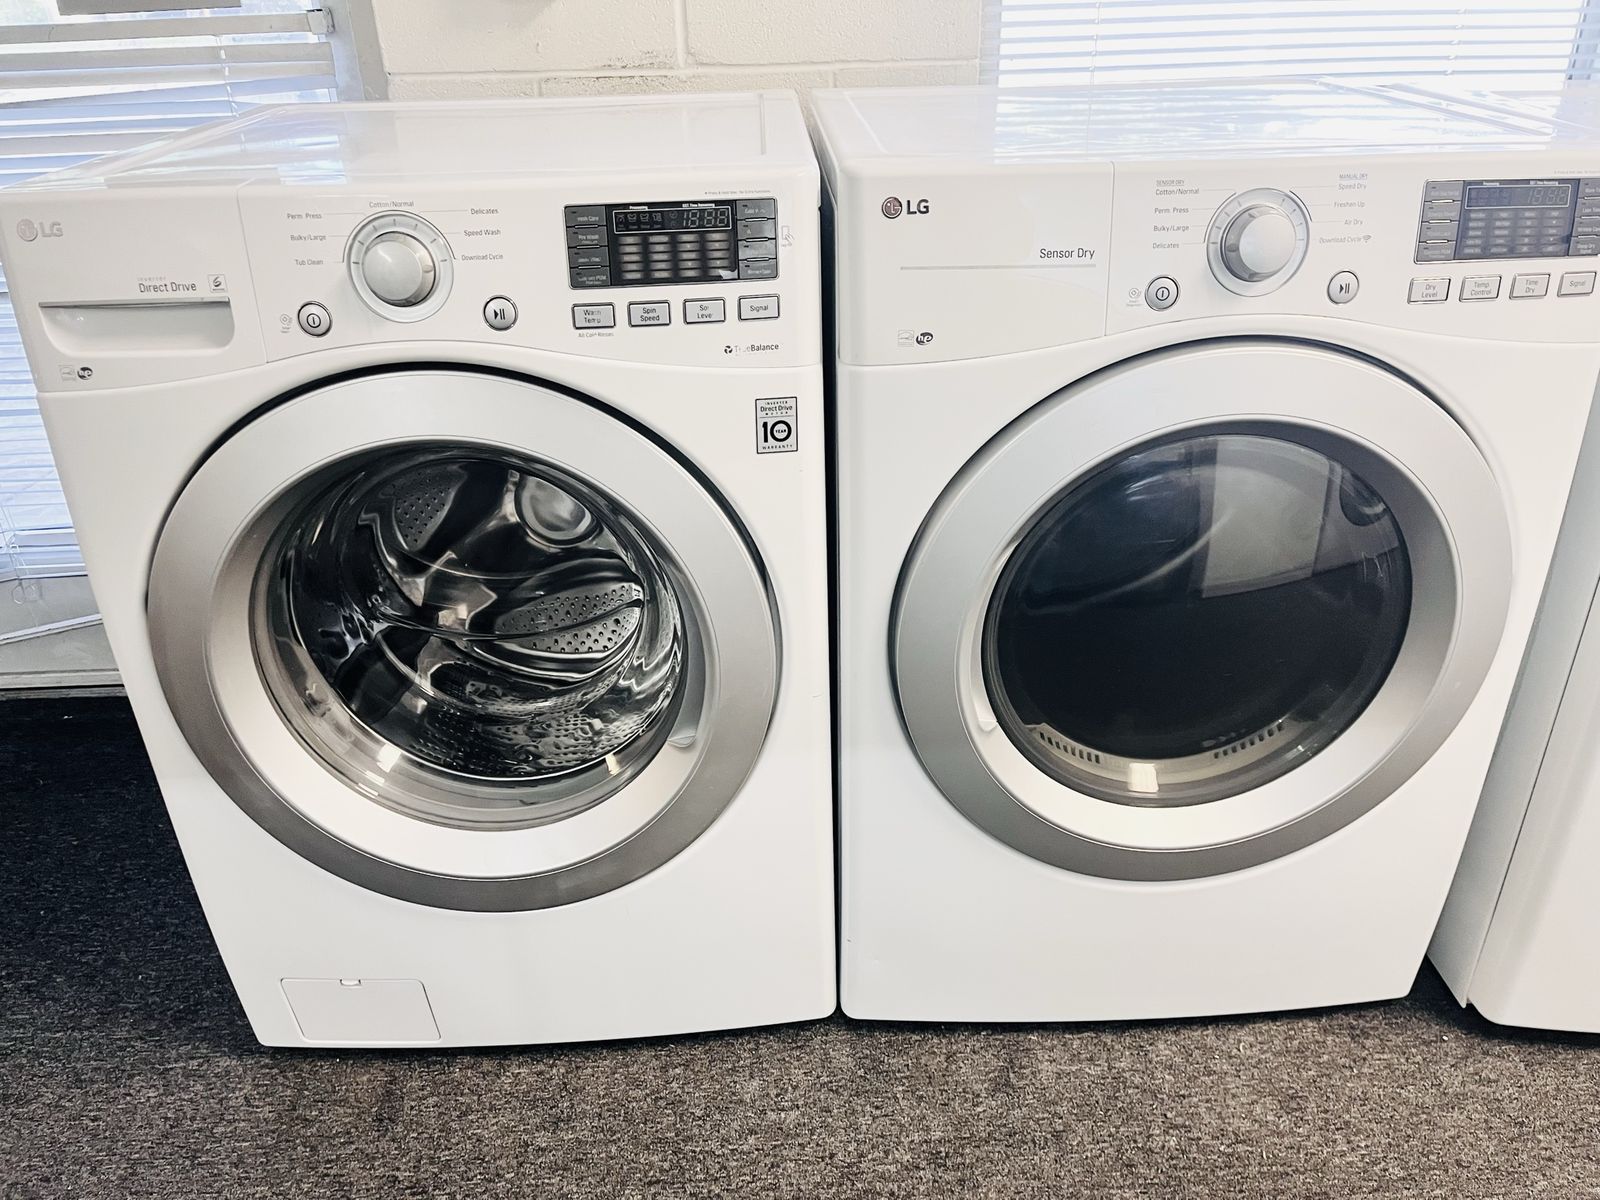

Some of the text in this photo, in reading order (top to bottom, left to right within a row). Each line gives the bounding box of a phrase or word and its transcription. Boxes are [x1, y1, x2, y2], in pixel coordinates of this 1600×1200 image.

[1156, 188, 1200, 196] Cotton/Normal
[369, 200, 414, 208] Cotton/Normal
[906, 199, 930, 215] LG
[1354, 218, 1363, 226] Dry
[38, 221, 64, 238] LG
[1154, 224, 1190, 232] Bulky/Large
[463, 229, 482, 237] Speed
[290, 234, 326, 242] Bulky/Large
[1040, 248, 1095, 260] Sensor Dry
[138, 282, 197, 293] Direct Drive
[1425, 284, 1436, 292] Dry
[1474, 282, 1490, 290] Temp
[1569, 280, 1587, 288] Signal
[1525, 286, 1536, 294] Dry
[750, 304, 768, 312] Signal
[640, 314, 660, 322] Speed
[762, 420, 792, 443] 10
